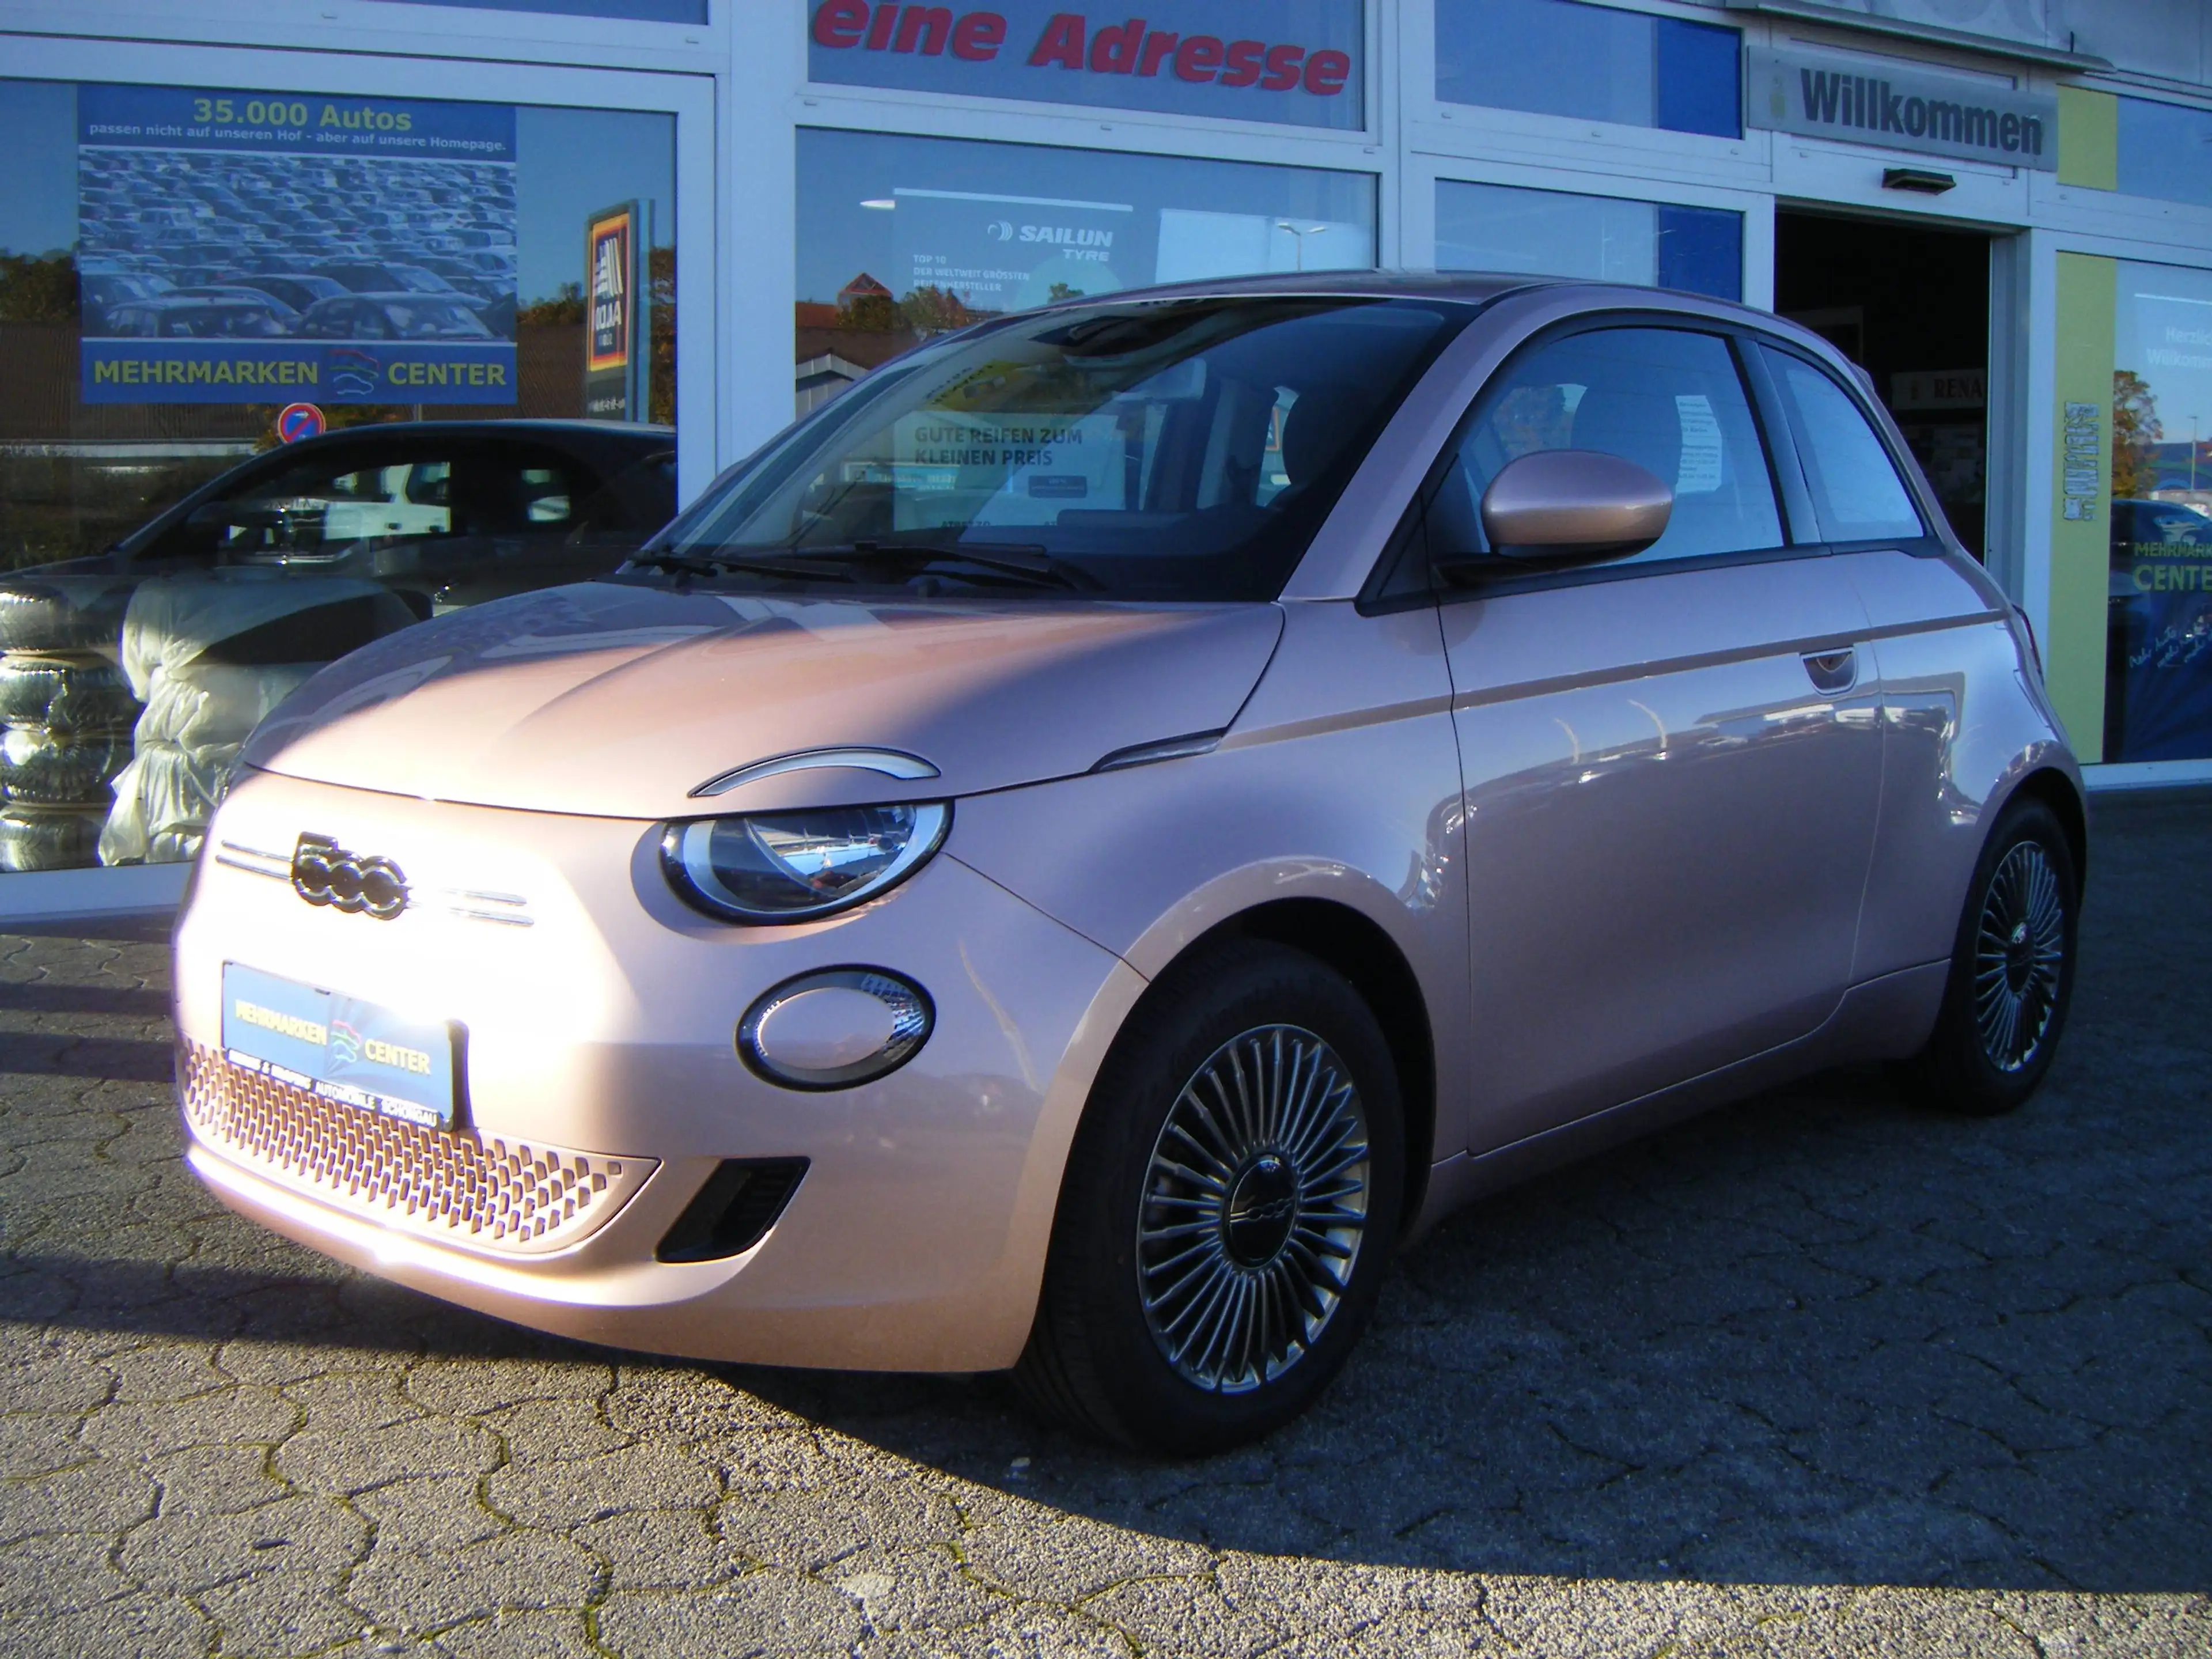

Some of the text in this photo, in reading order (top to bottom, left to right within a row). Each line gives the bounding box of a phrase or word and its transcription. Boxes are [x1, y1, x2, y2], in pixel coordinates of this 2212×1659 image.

[812, 0, 1351, 96] eine Adresse
[193, 98, 412, 131] 35.000 Autos
[1800, 67, 2043, 156] Willkommen
[89, 124, 141, 137] passen
[146, 124, 183, 137] nicht
[187, 125, 211, 138] auf
[215, 129, 272, 141] unseren
[278, 130, 302, 142] Hof
[316, 131, 348, 144] aber
[351, 132, 376, 145] auf
[379, 136, 426, 147] unsere
[430, 136, 506, 153] Homepage.
[1018, 225, 1113, 247] SAILUN
[912, 254, 946, 264] TOP 10
[1062, 248, 1110, 262] TYRE
[913, 267, 933, 276] DER
[934, 268, 981, 278] WELTWEIT
[94, 359, 507, 385] MEHRMARKEN CENTER
[914, 427, 1083, 445] GUTE REIFEN ZUM
[915, 449, 1053, 466] KLEINEN PREIS
[234, 998, 432, 1076] MEHRMARKEN CENTER
